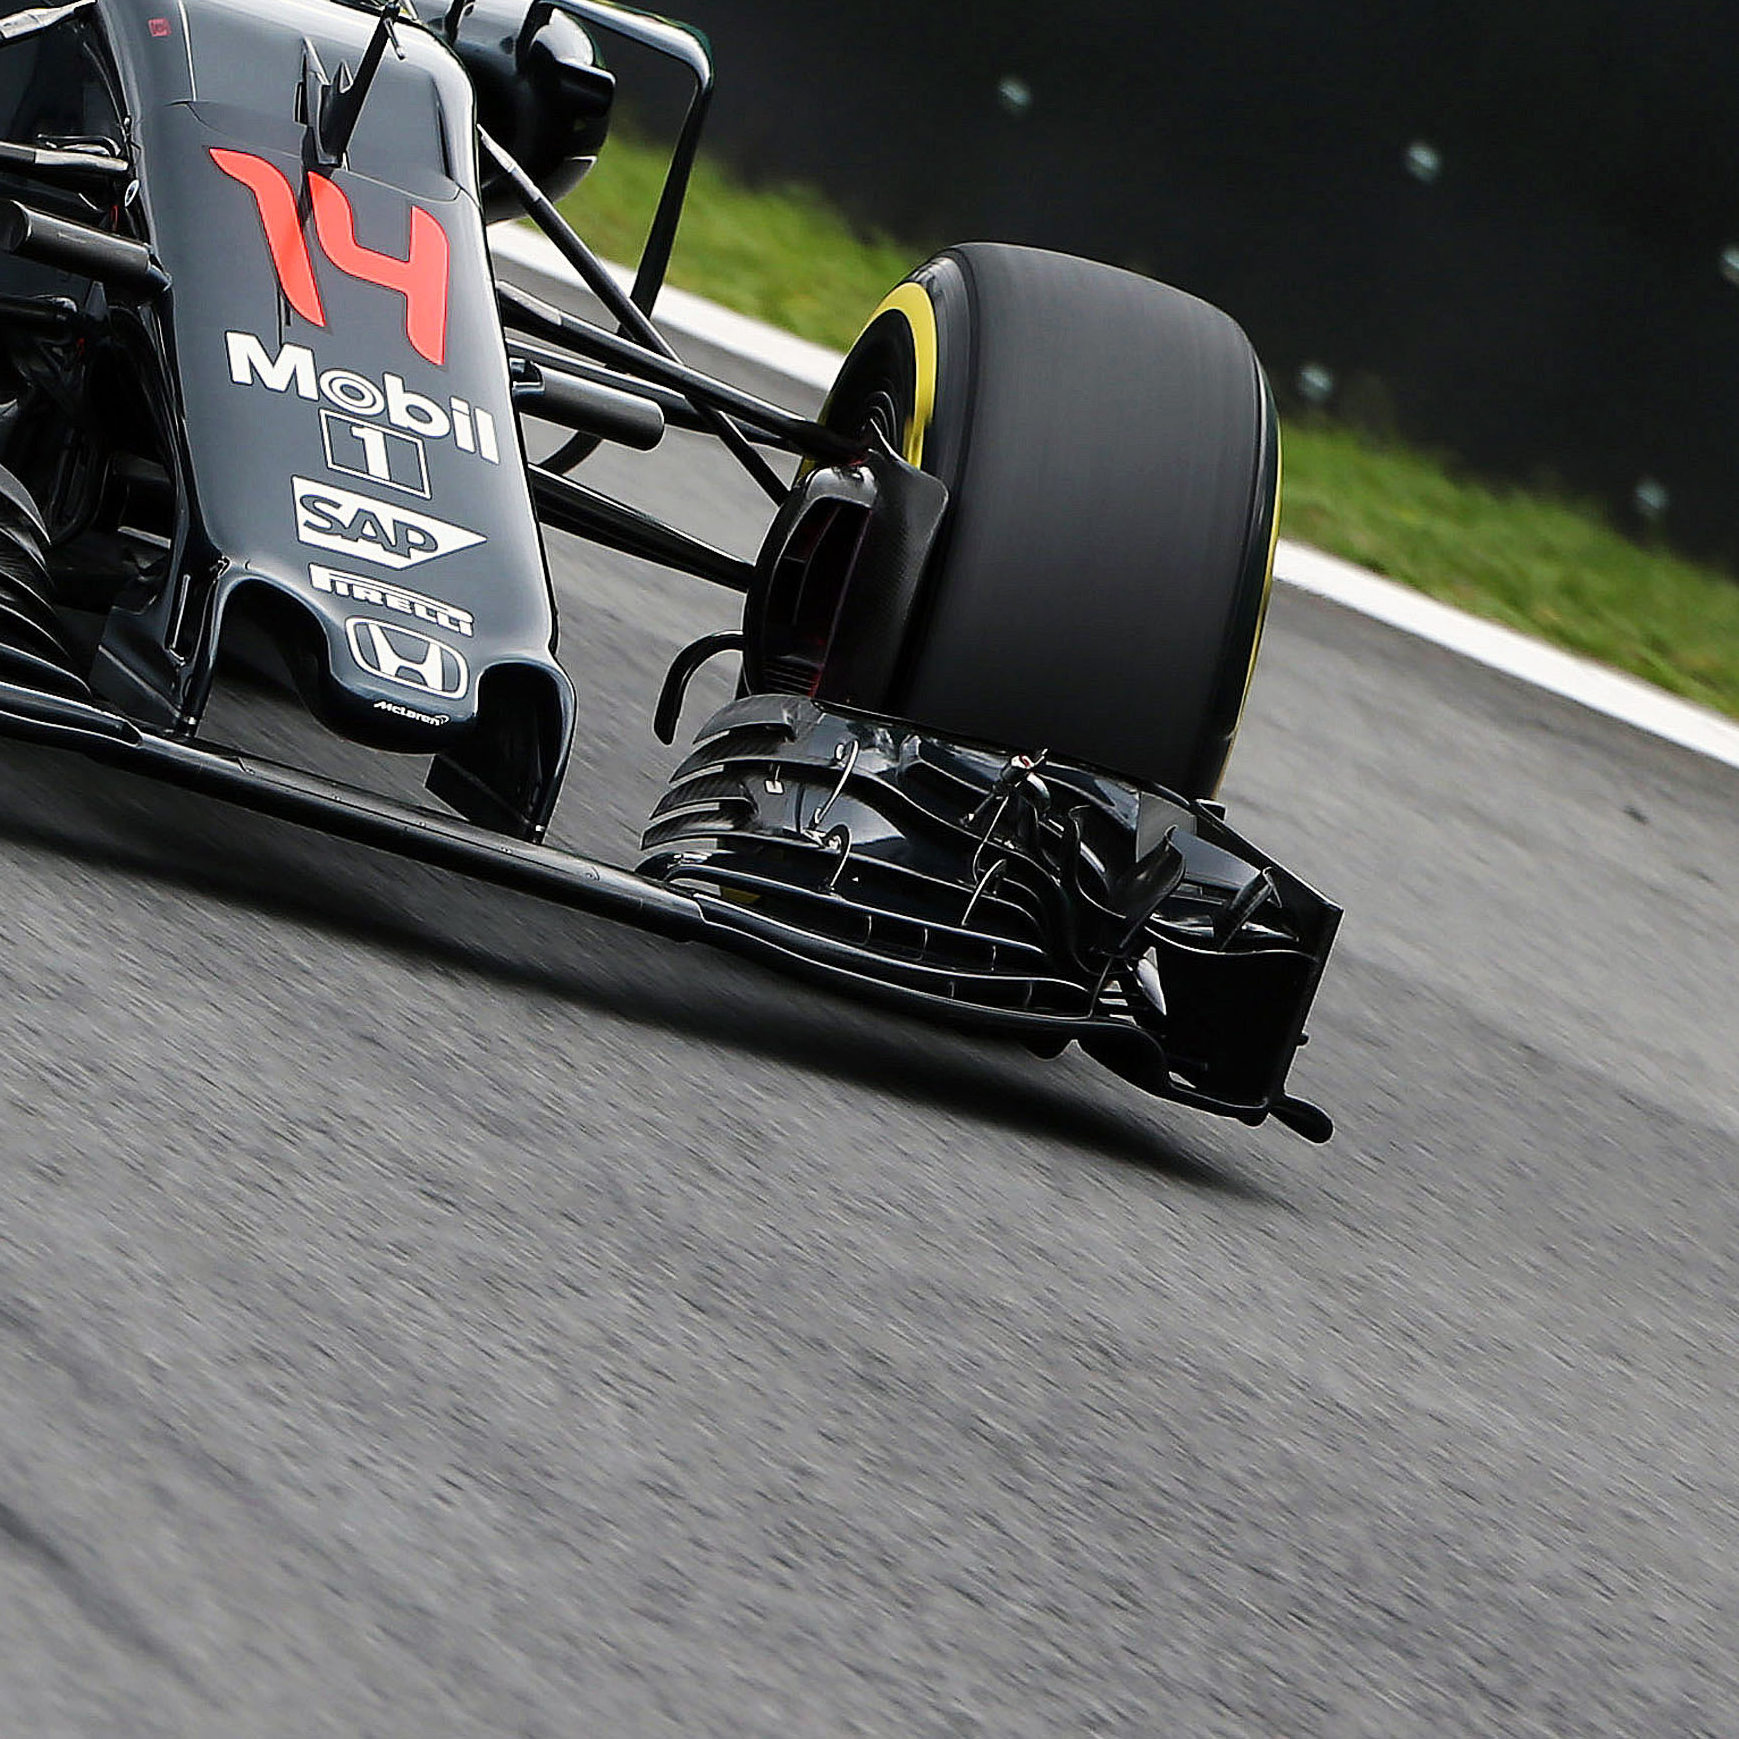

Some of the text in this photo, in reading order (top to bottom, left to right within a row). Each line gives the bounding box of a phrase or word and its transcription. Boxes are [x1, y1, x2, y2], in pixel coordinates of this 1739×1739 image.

[208, 147, 450, 366] 14
[224, 329, 500, 466] Mobil
[349, 423, 393, 482] 1
[299, 493, 439, 561] SAP
[309, 562, 475, 638] PIRELLI
